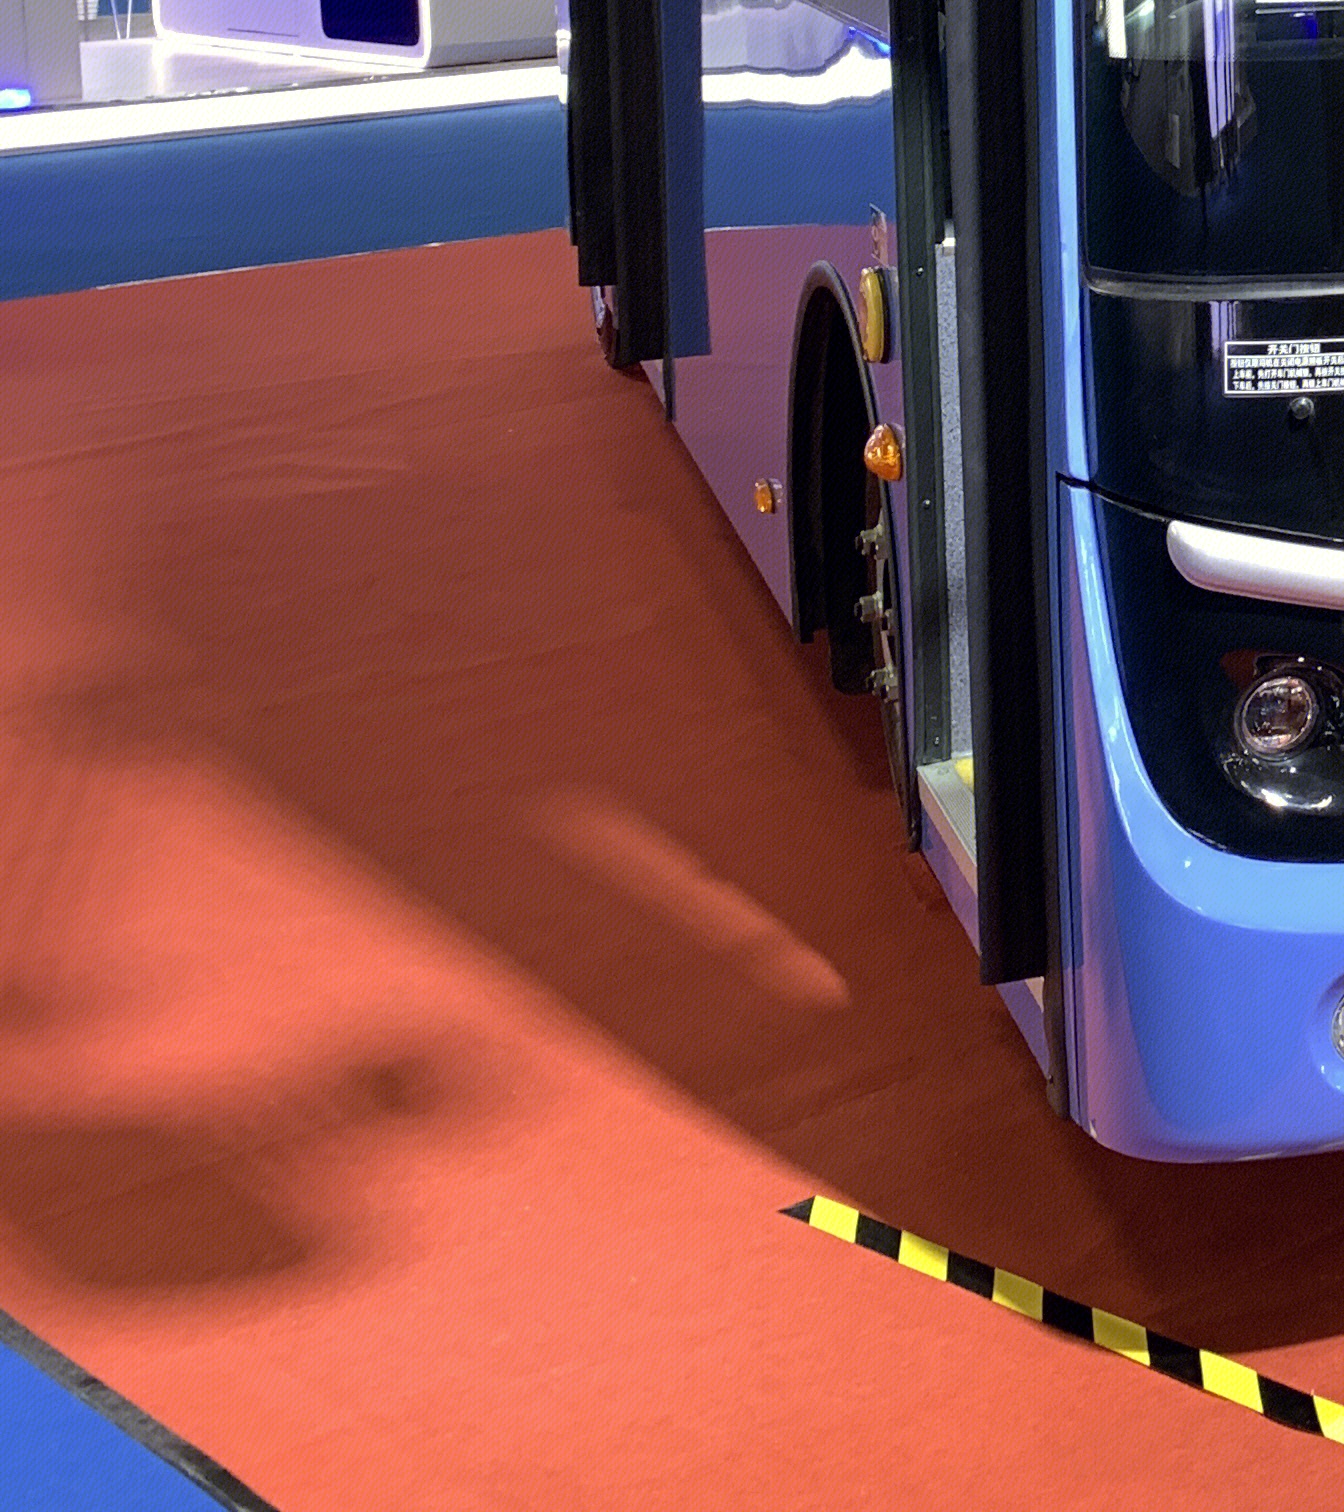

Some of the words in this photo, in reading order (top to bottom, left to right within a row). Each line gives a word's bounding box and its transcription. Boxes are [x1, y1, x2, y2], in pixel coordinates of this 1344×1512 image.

[1267, 343, 1321, 355] 开关门按钮
